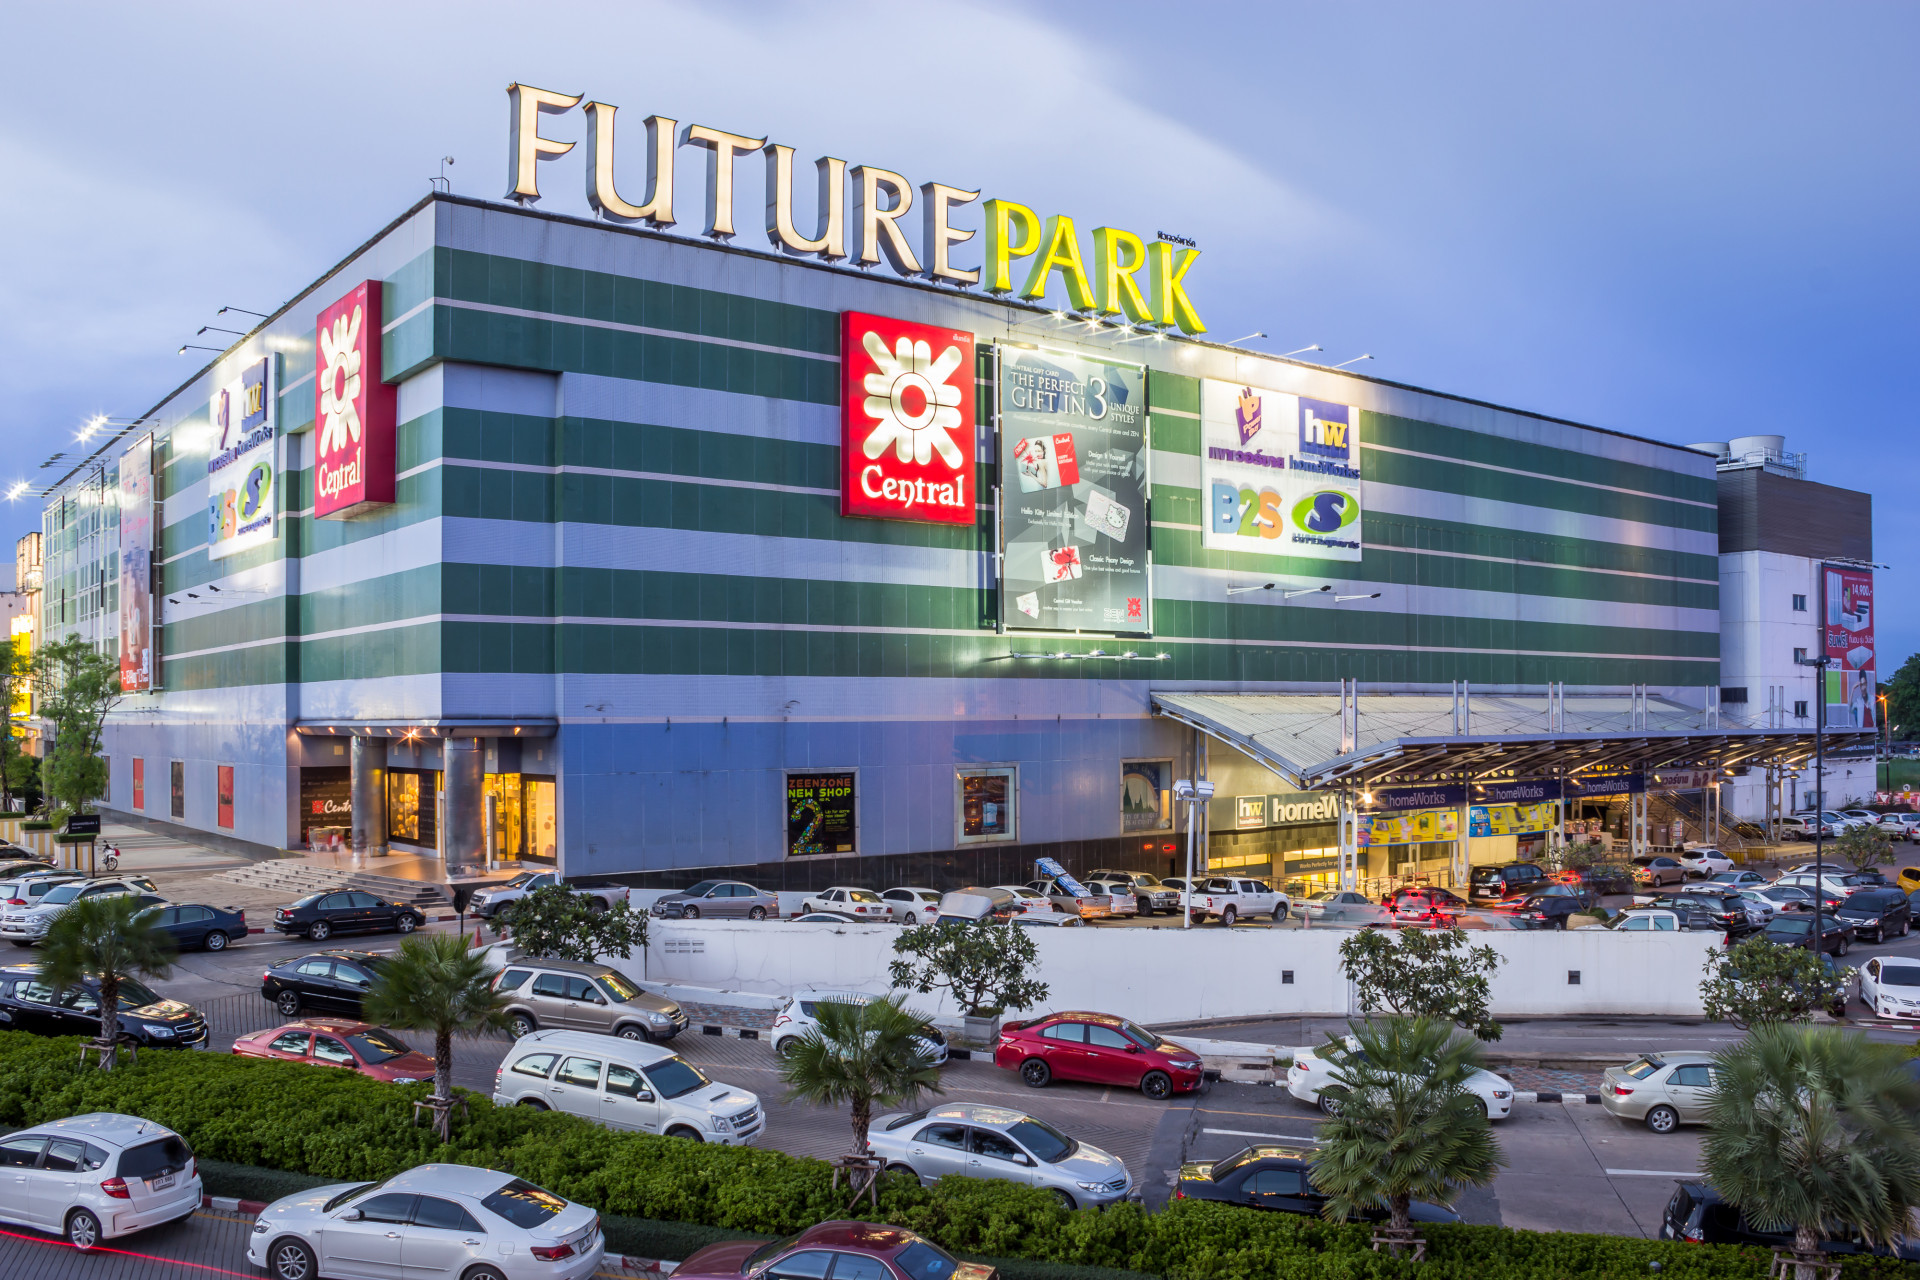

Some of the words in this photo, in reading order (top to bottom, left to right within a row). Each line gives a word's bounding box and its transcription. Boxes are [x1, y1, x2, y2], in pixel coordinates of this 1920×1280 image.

[504, 81, 981, 288] FUTURE
[982, 198, 1208, 335] PARK
[1011, 372, 1034, 387] THE
[1039, 376, 1086, 395] PERFECT
[1011, 387, 1057, 412] GIFT
[1064, 395, 1086, 417] IN
[1089, 377, 1108, 421] 3
[1110, 402, 1140, 415] UNIQUE
[1111, 413, 1135, 424] STYLES
[319, 446, 361, 500] Central
[1289, 455, 1361, 480] homeWorks
[861, 465, 965, 508] Central
[1212, 483, 1283, 540] B2S
[788, 777, 851, 788] ZEENZONE
[788, 788, 813, 798] NEW
[819, 787, 851, 798] SHOP
[1496, 786, 1544, 800] homeWorks
[1587, 779, 1630, 793] homeWorks
[1389, 791, 1446, 807] homeWorks
